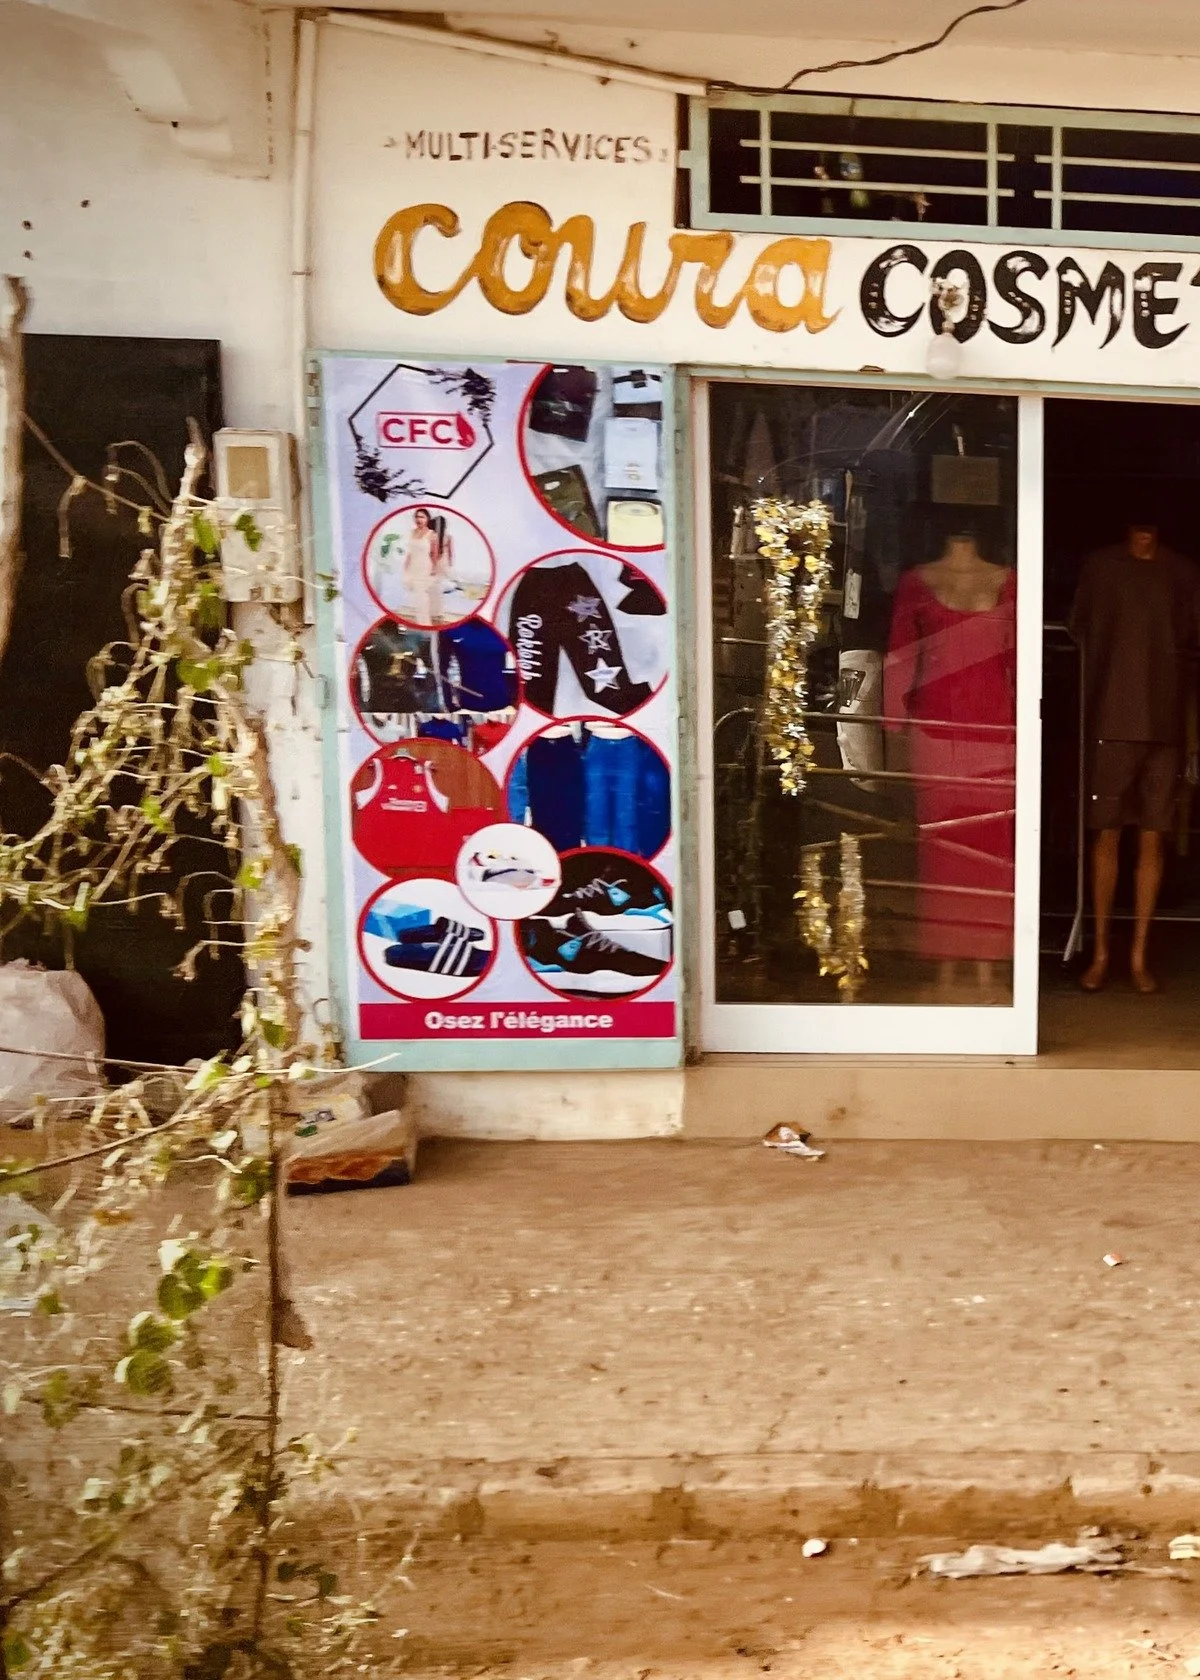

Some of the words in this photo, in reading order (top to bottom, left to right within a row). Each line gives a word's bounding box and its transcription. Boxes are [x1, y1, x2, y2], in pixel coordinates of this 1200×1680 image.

[382, 418, 452, 444] CFC
[424, 1011, 486, 1030] Osez
[489, 1011, 614, 1033] l'élégance
